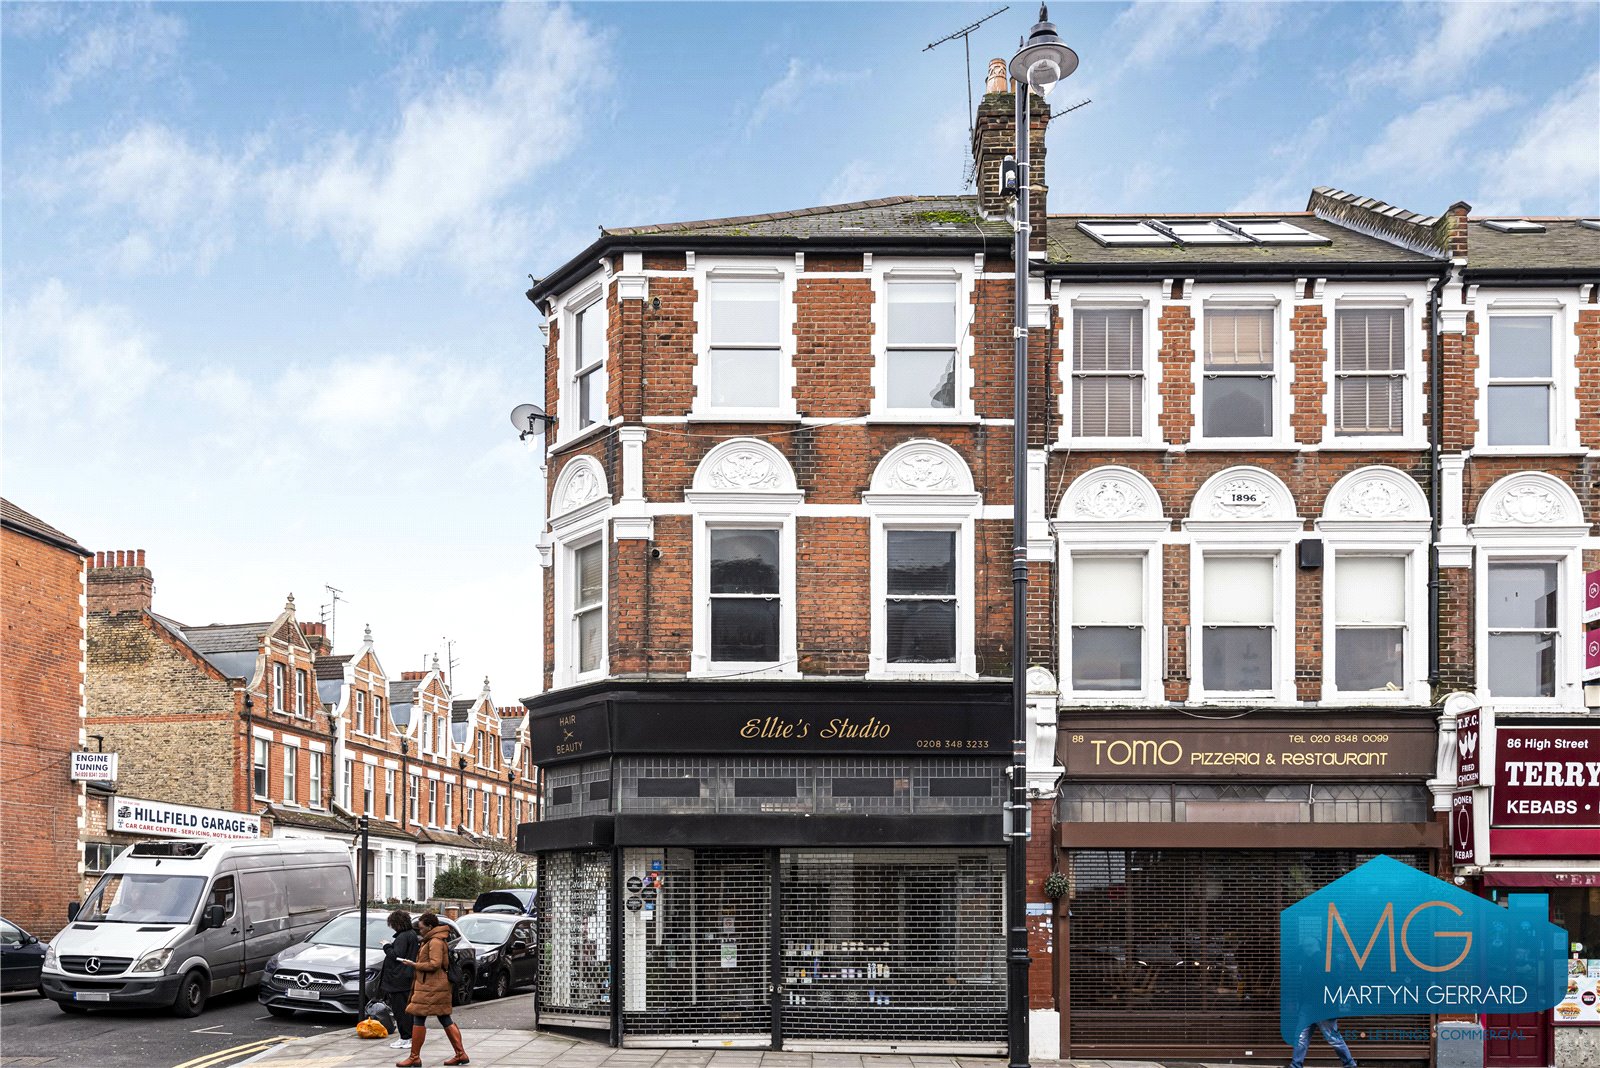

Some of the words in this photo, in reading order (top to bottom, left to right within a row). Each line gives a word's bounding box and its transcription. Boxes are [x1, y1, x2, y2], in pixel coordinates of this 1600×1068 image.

[1232, 494, 1257, 502] 1896
[560, 714, 576, 726] HAIR
[1457, 714, 1479, 729] T.F.C.
[740, 716, 811, 738] Ellie's
[820, 716, 891, 738] Studio
[917, 740, 942, 748] 0208
[945, 740, 963, 748] 348
[966, 740, 989, 748] 3233
[1072, 735, 1084, 743] 88
[1310, 735, 1331, 743] 020
[1334, 735, 1358, 743] 8348
[1362, 735, 1389, 743] 0099
[1507, 738, 1522, 749] 86
[1525, 738, 1551, 751] High
[1554, 738, 1589, 749] Street
[556, 741, 583, 755] BEAUTY
[76, 754, 109, 763] ENGINE
[1265, 753, 1276, 765] &
[75, 763, 109, 772] TUNING
[1461, 763, 1475, 773] FRIED
[1458, 772, 1479, 783] CHICKEN
[1453, 795, 1473, 807] DONER
[1507, 800, 1578, 814] KEBABS
[135, 807, 198, 827] HILLFIELD
[201, 816, 246, 833] GARAGE
[155, 826, 177, 834] CENTRE
[1454, 849, 1474, 860] KEBAB
